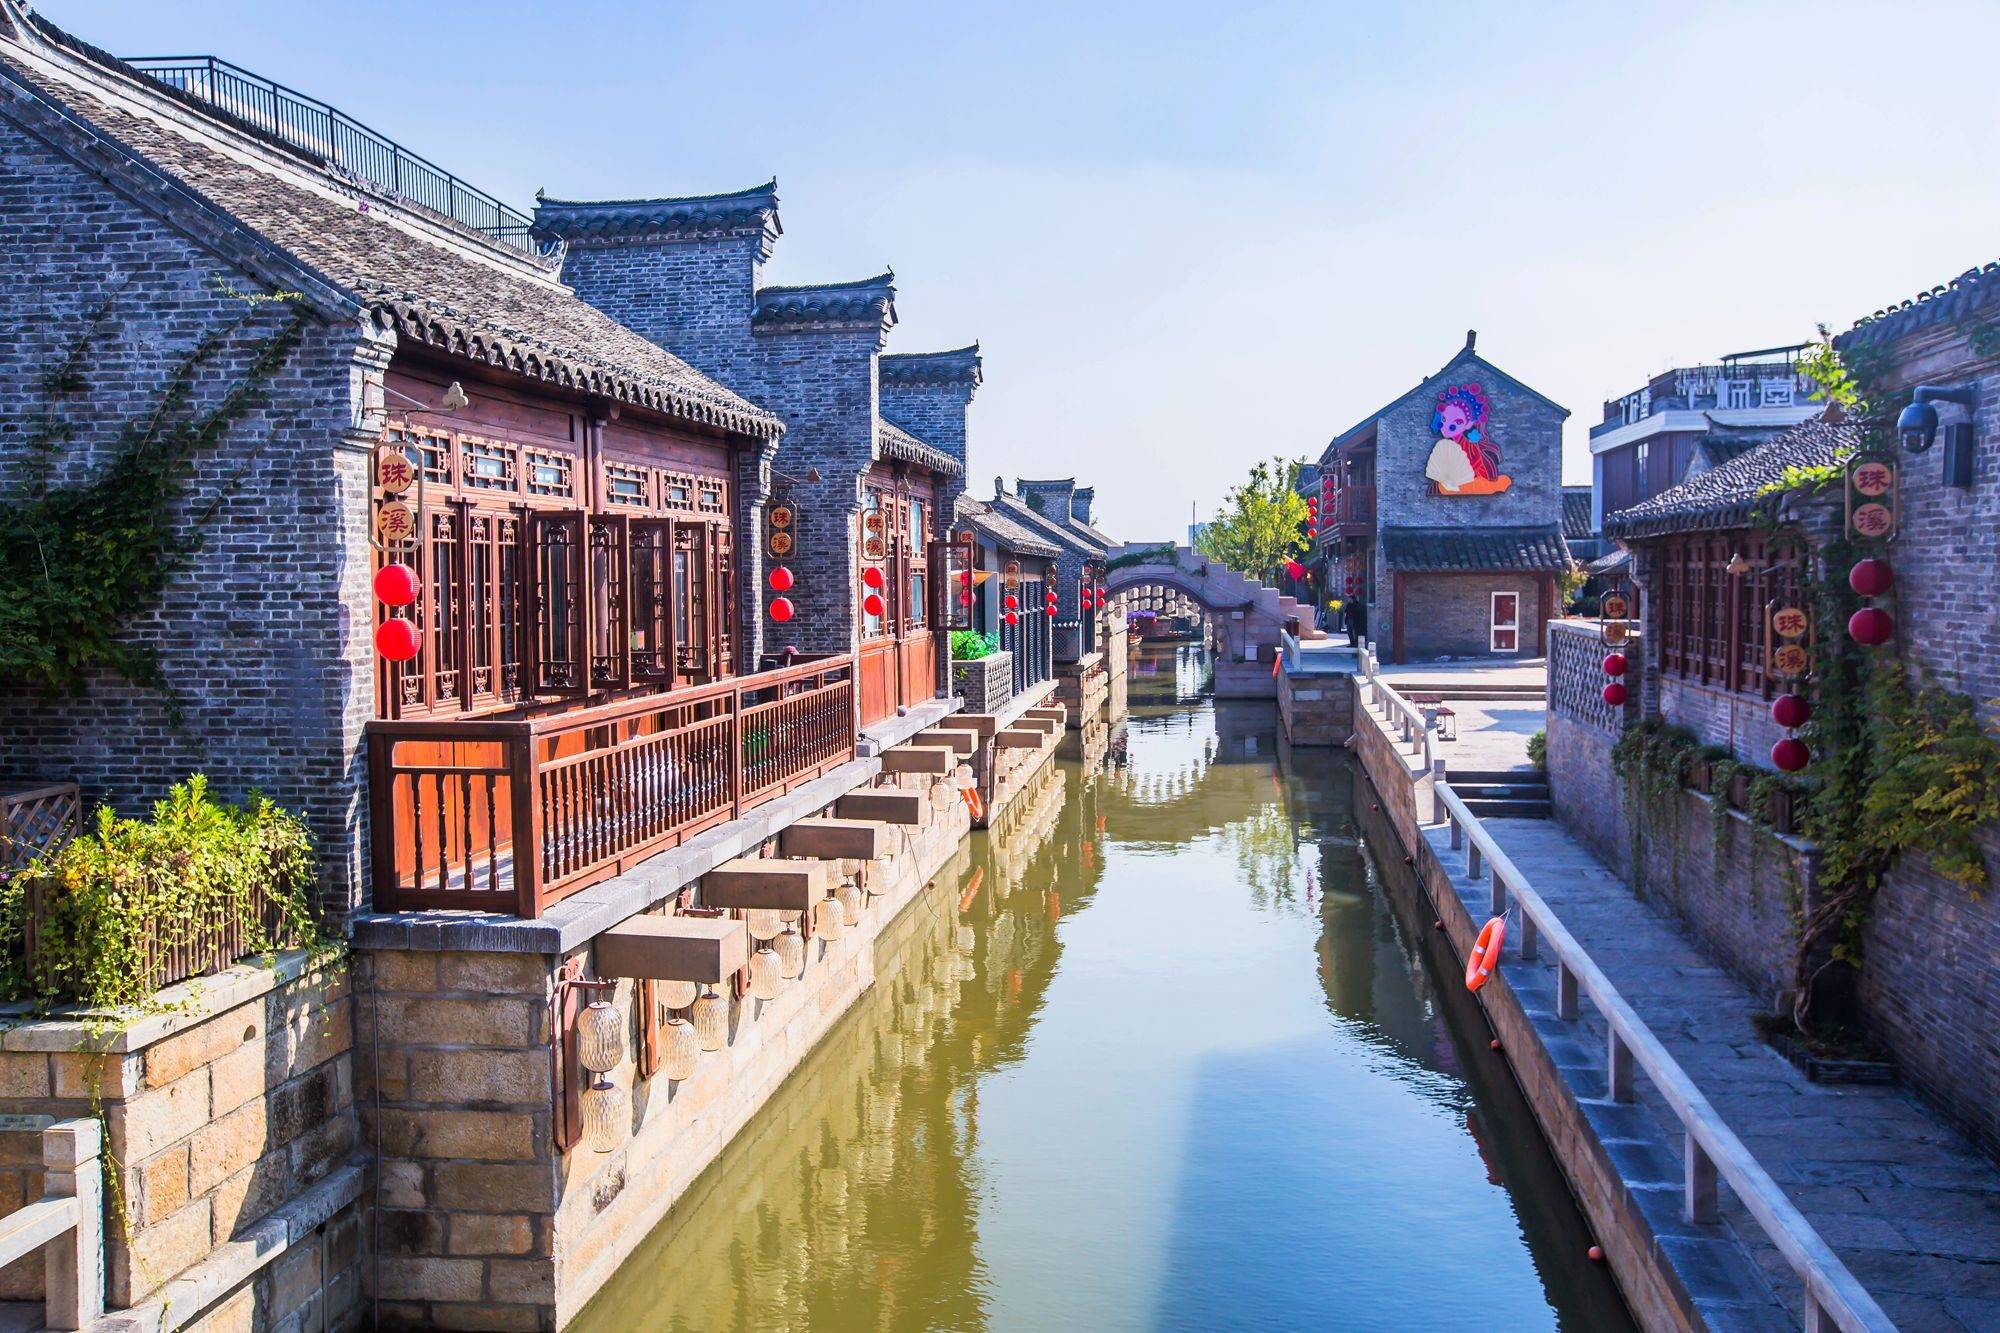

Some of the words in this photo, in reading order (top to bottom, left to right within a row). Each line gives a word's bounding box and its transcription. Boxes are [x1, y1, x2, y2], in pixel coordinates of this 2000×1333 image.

[381, 462, 410, 533] 珠溪
[1858, 469, 1889, 531] 珠溪
[773, 511, 788, 550] 珠溪
[867, 518, 882, 552] 珠溪
[1778, 614, 1805, 669] 珠溪
